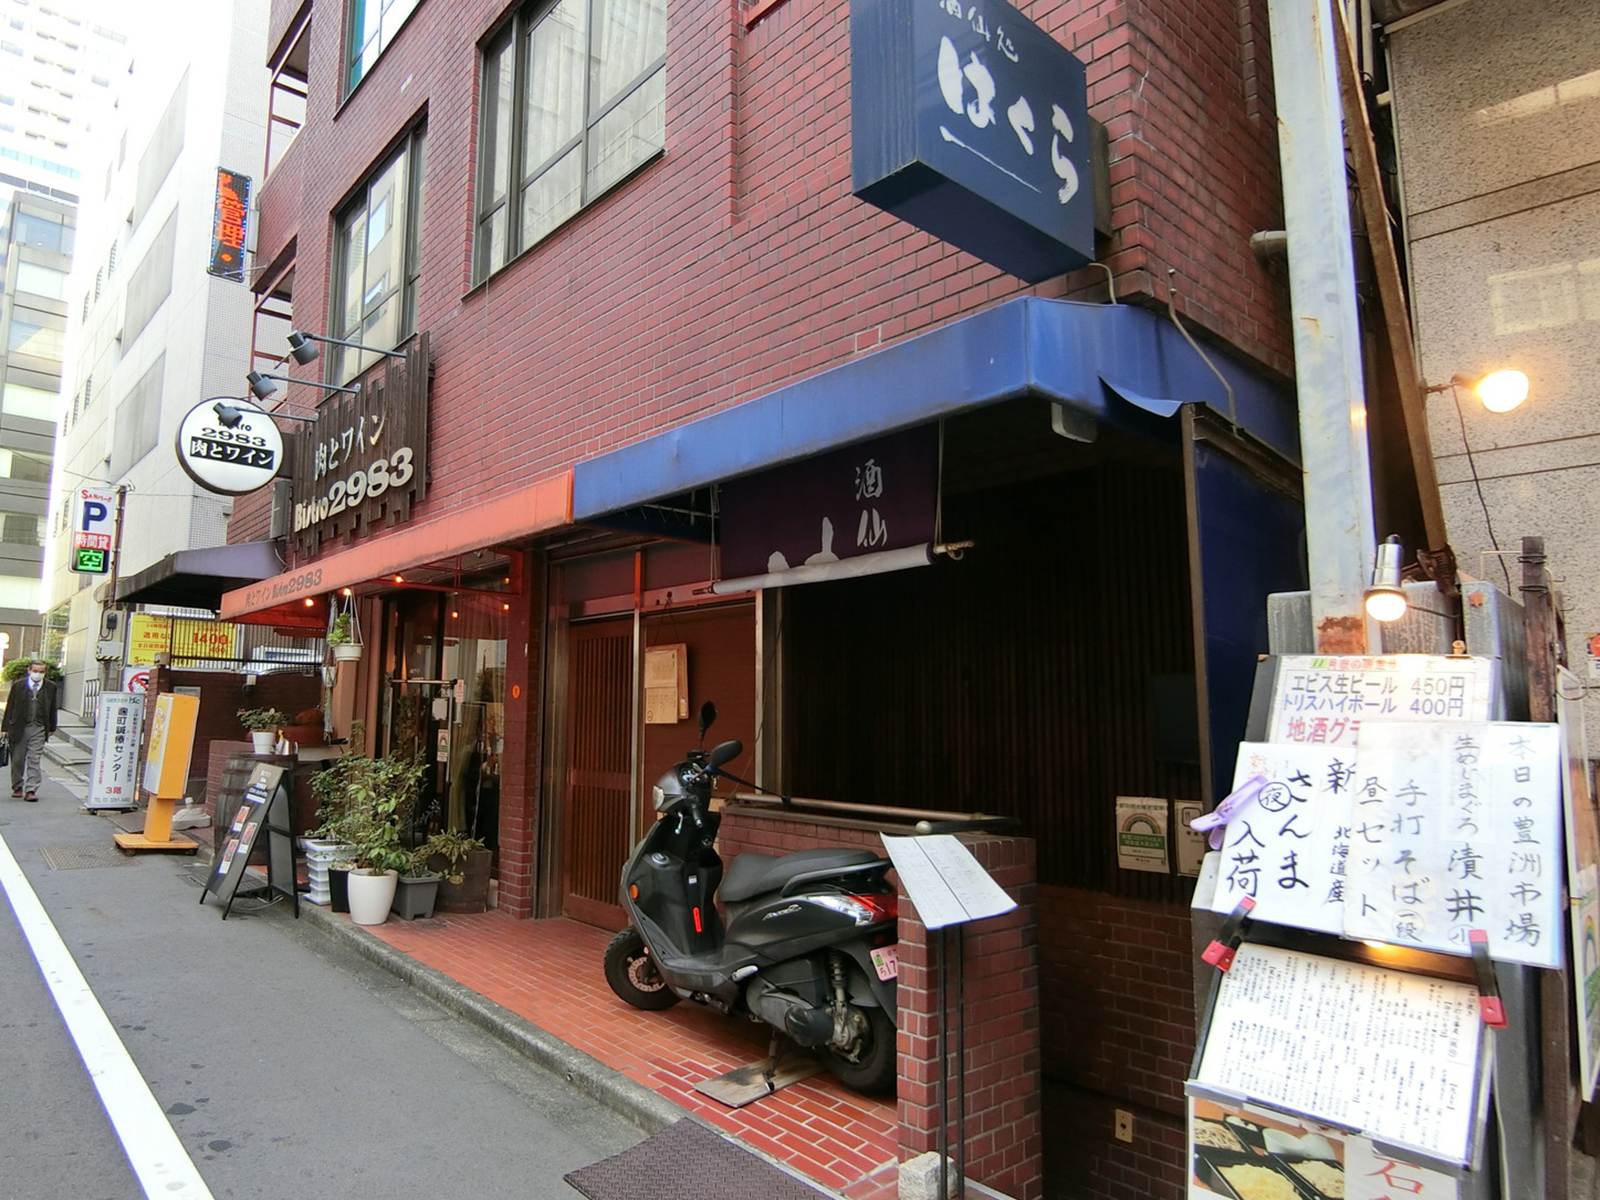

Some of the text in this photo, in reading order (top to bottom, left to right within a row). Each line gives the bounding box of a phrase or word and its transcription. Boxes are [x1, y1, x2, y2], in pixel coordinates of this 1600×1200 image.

[191, 439, 273, 466] 肉とワイン
[201, 427, 266, 447] 2983
[315, 410, 388, 482] 肉とワイン
[82, 501, 108, 531] P
[855, 458, 888, 548] 酒仙
[77, 549, 103, 571] 空
[1283, 694, 1464, 717] トリスハイボール 400円
[1411, 676, 1466, 698] 450円
[1278, 769, 1312, 889] さんま
[1356, 776, 1387, 917] 昼セット
[1503, 734, 1542, 947] 本日の豊洲市場
[1226, 820, 1266, 897] 入荷
[1363, 1155, 1425, 1200] 石
